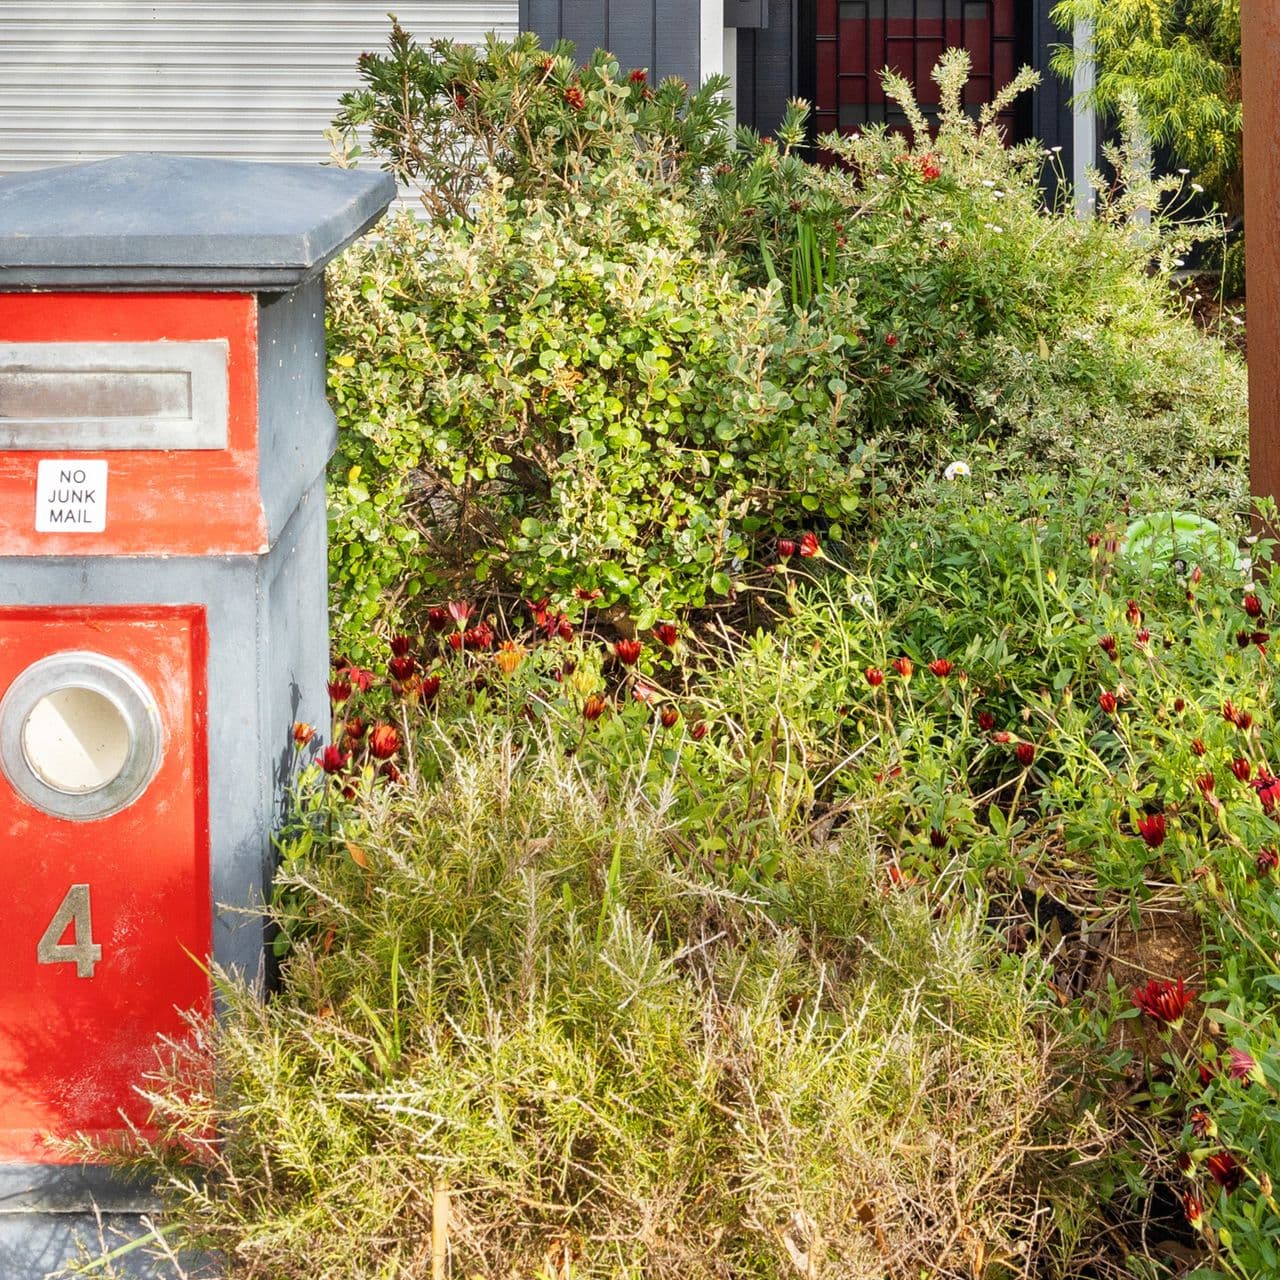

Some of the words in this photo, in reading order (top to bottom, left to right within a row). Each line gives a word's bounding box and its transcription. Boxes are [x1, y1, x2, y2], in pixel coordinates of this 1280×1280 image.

[60, 469, 86, 484] NO
[47, 489, 96, 504] JUNK
[49, 509, 93, 523] MAIL
[37, 883, 102, 978] 4
